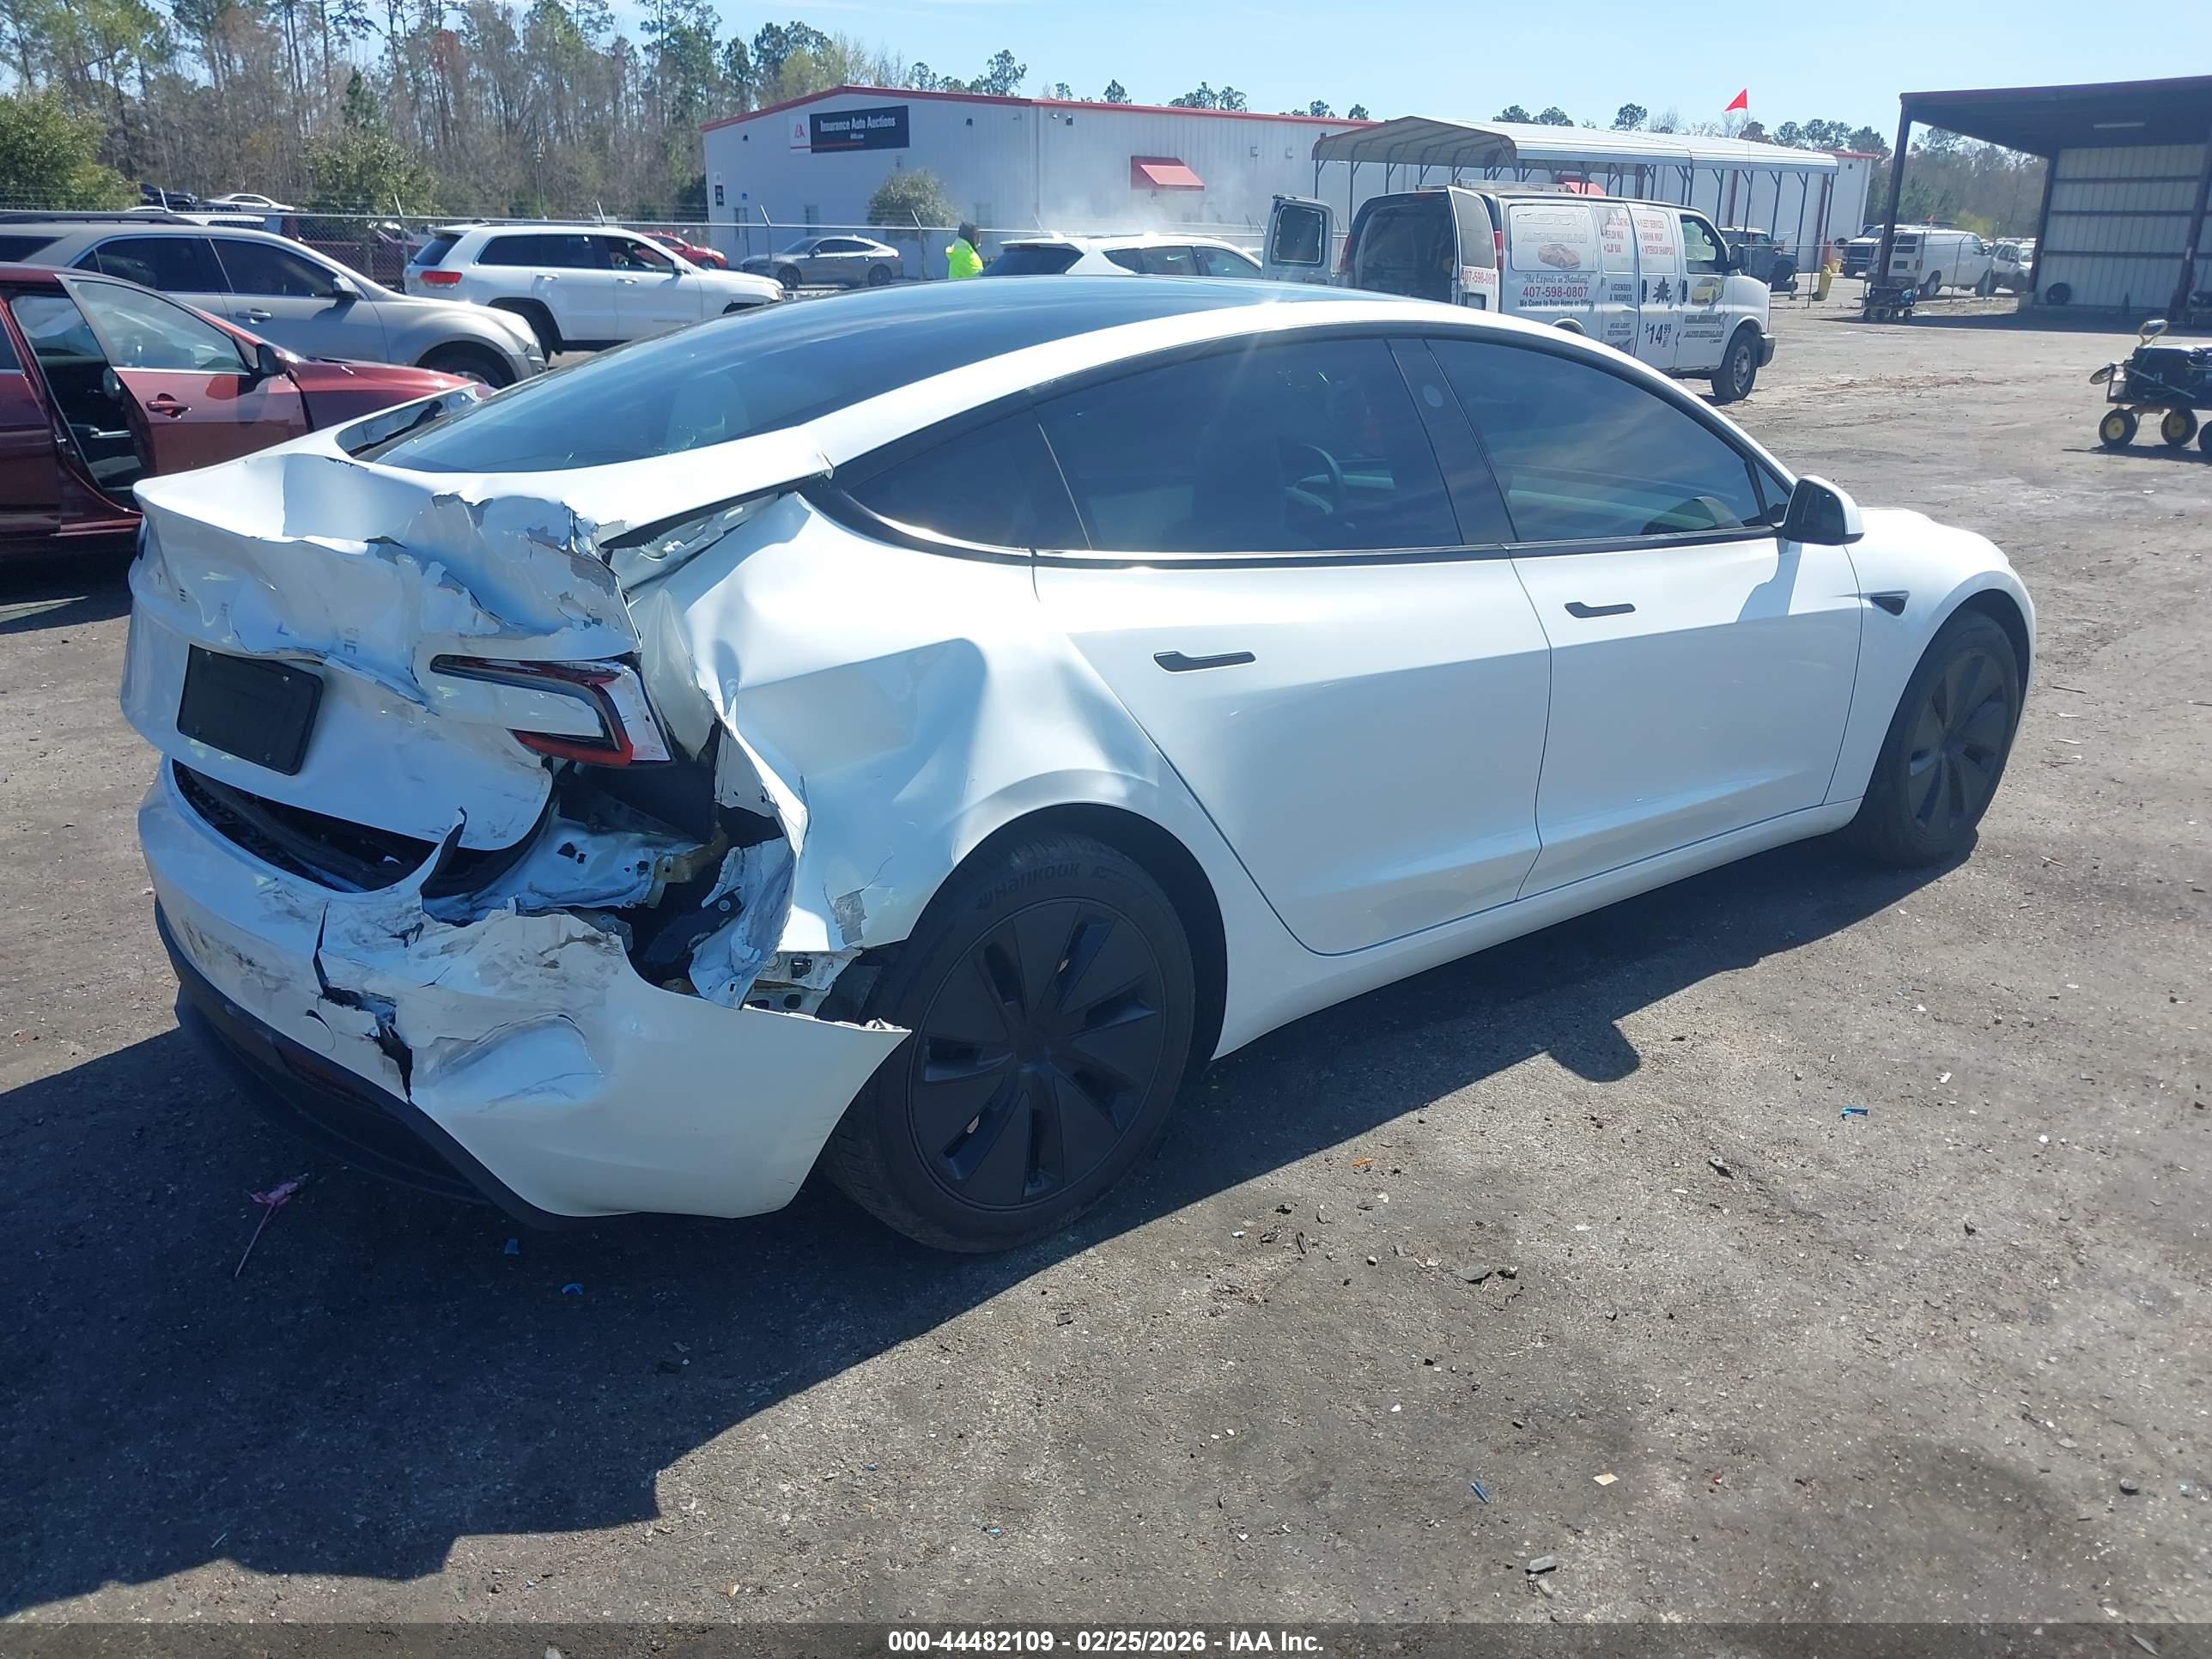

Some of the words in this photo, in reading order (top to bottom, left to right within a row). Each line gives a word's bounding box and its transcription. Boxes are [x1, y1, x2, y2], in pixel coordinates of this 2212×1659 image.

[820, 120, 849, 132] Insurance
[850, 116, 866, 130] Auto
[866, 115, 896, 129] Auctions
[1524, 273, 1534, 283] The
[1535, 274, 1557, 286] Experts
[1522, 286, 1589, 298] 407-598-0807
[1614, 294, 1633, 302] INSURED
[1519, 299, 1528, 307] We
